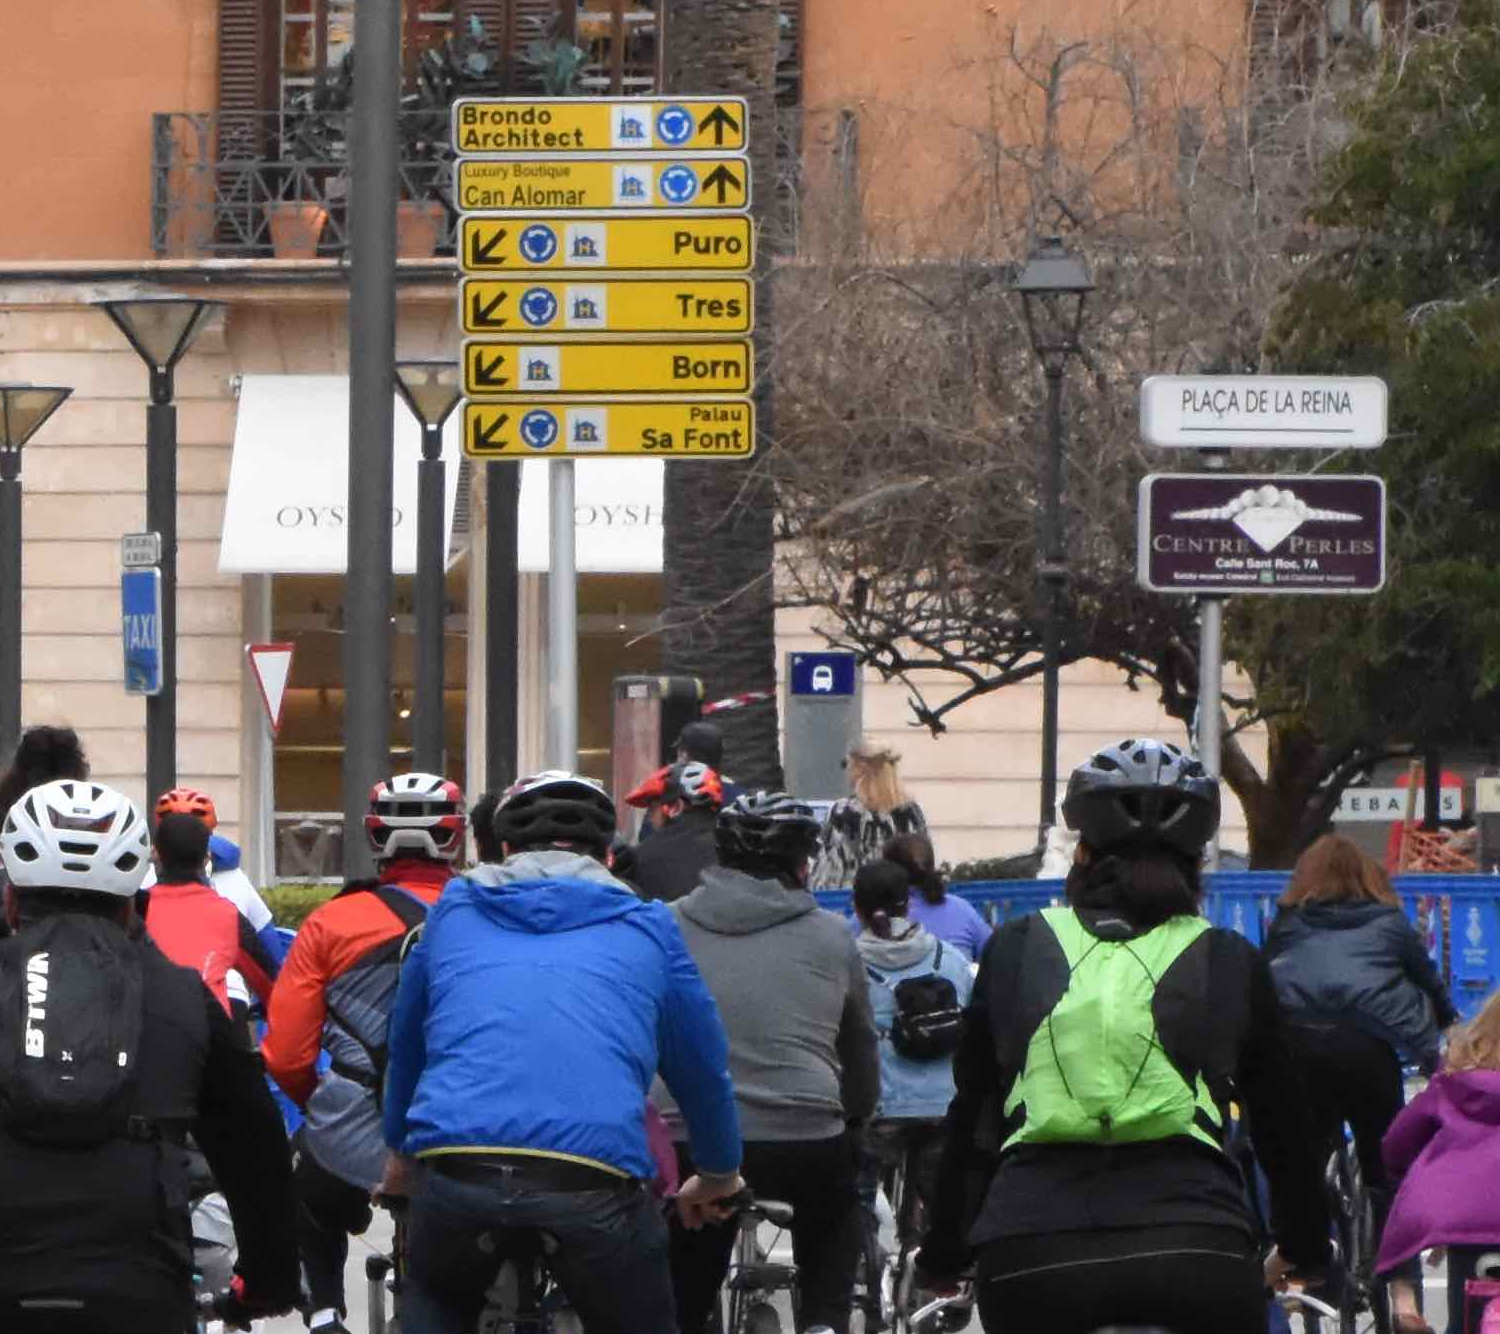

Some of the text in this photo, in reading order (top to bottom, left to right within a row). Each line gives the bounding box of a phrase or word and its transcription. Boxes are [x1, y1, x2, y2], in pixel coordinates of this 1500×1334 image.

[463, 107, 551, 126] Brondo
[464, 129, 583, 148] Architect
[513, 164, 571, 179] Boutique
[465, 185, 586, 206] Can Alomar
[674, 232, 742, 255] Puro
[676, 294, 741, 317] Tres
[673, 356, 741, 379] Born
[1182, 389, 1353, 419] PLAÇA DE LA REINA
[690, 408, 742, 422] Palau
[642, 429, 742, 450] Sa Font
[1289, 534, 1376, 555] PERLES
[123, 613, 157, 650] TAXI
